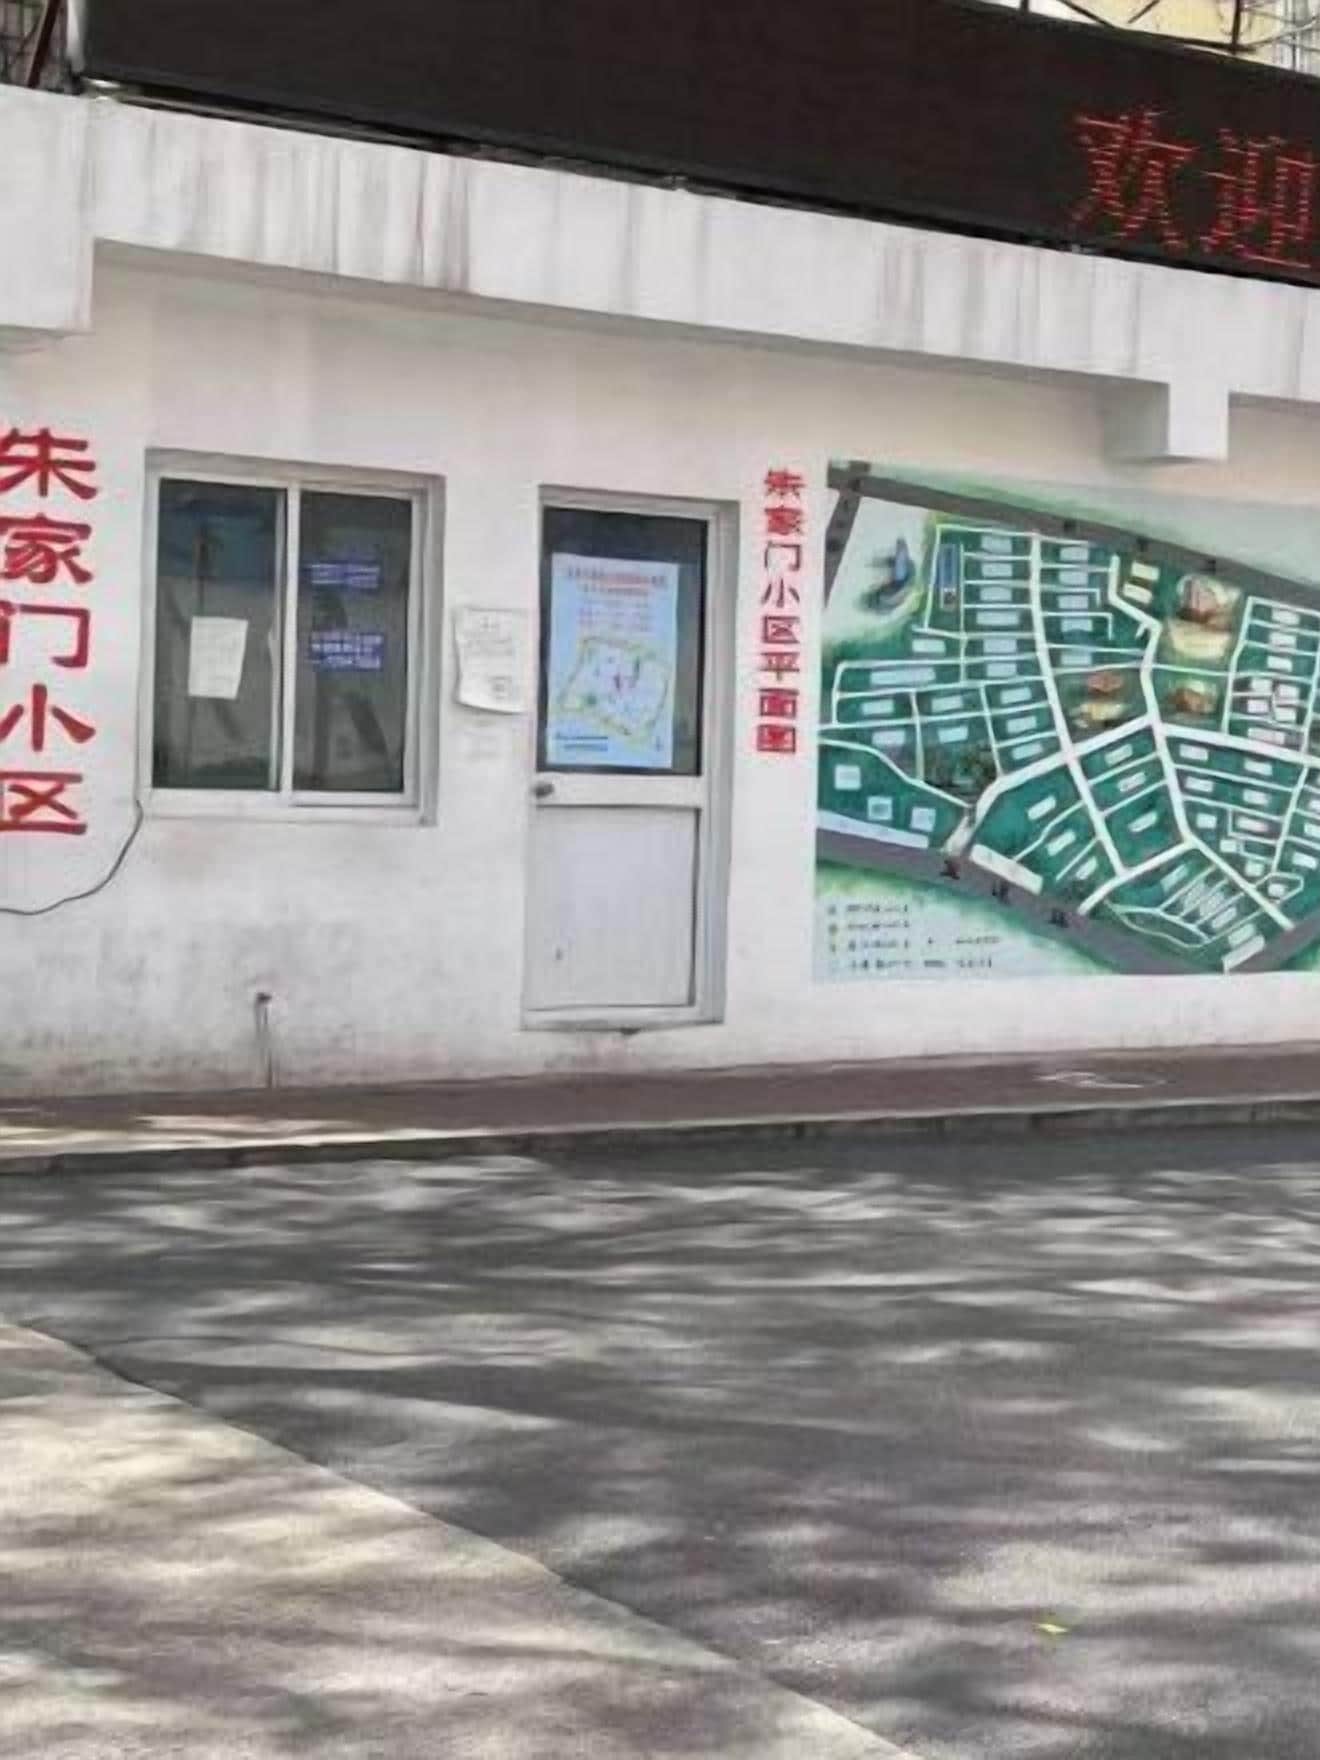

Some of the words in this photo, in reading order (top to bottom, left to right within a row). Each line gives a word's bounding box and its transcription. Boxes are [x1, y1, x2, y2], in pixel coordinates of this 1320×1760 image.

[0, 428, 97, 836] 朱家门小区
[756, 468, 804, 752] 朱家门小区平面图
